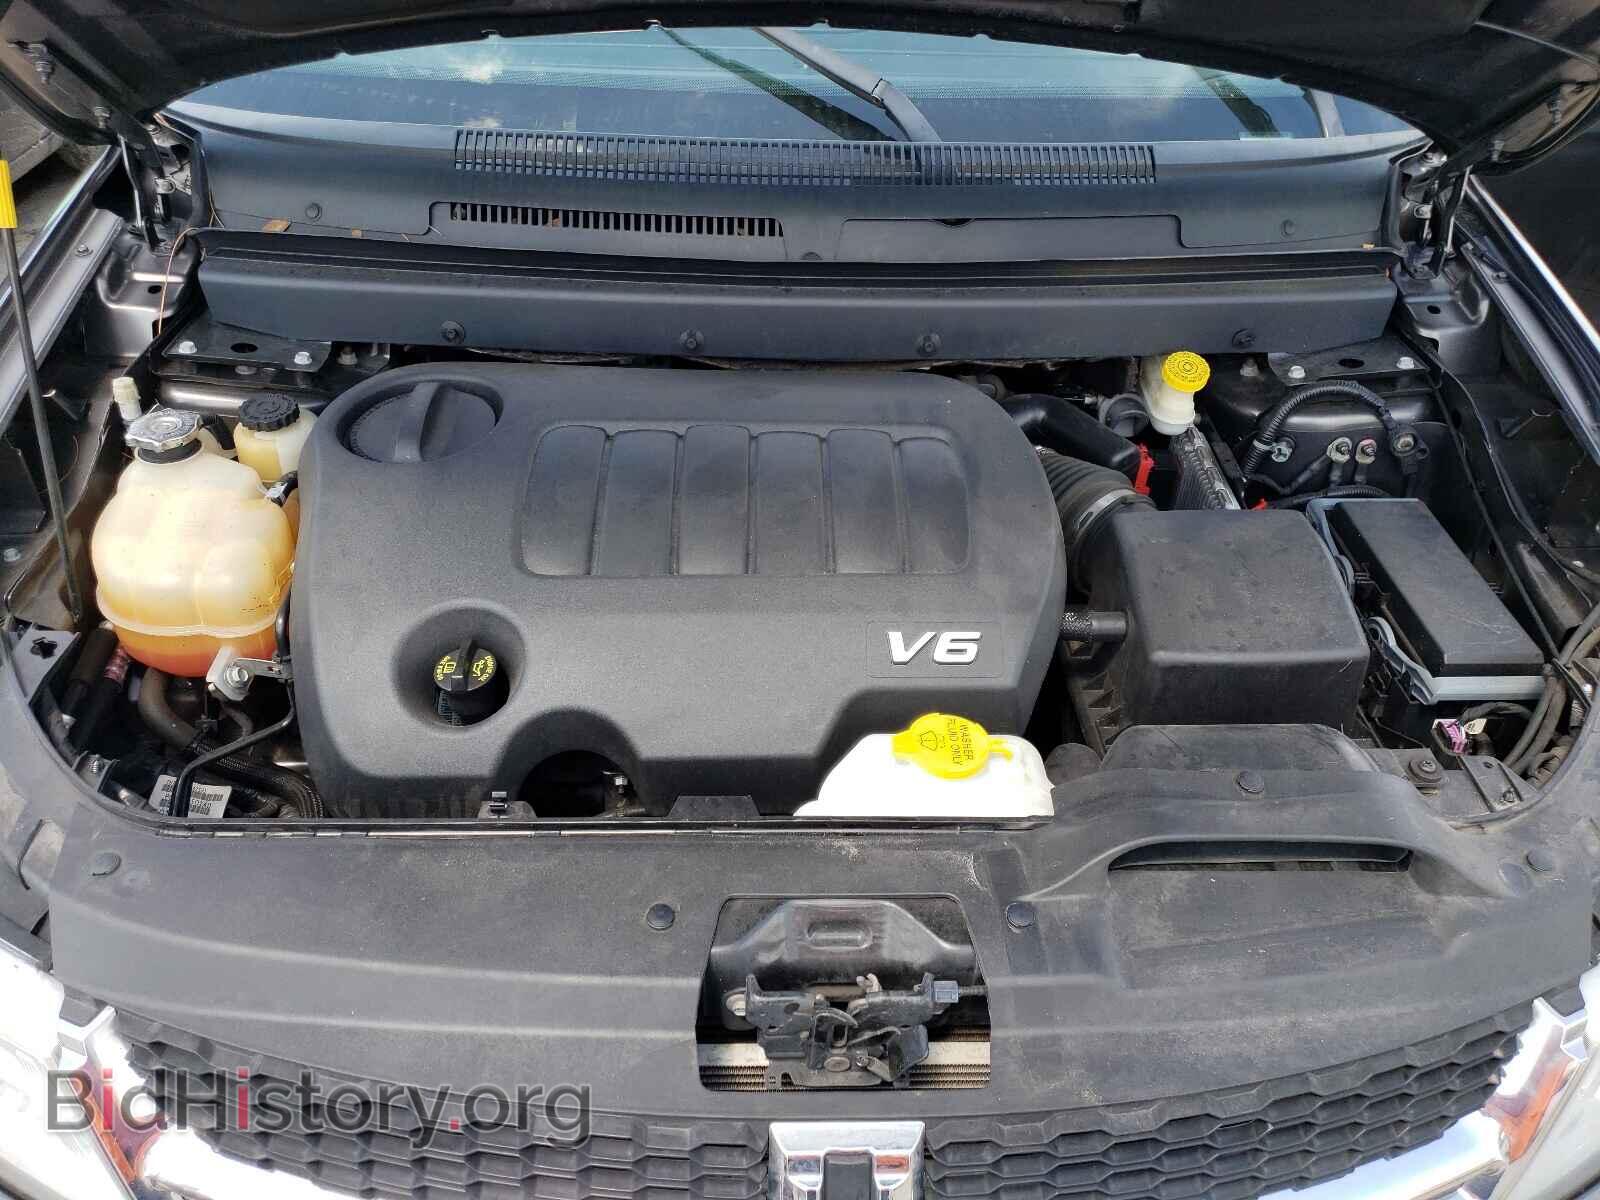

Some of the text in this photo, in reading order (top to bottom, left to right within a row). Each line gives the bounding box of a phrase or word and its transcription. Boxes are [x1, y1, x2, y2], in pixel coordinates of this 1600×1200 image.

[887, 631, 982, 665] V6
[947, 718, 964, 766] FLUID ONLY
[959, 724, 974, 761] WASHER
